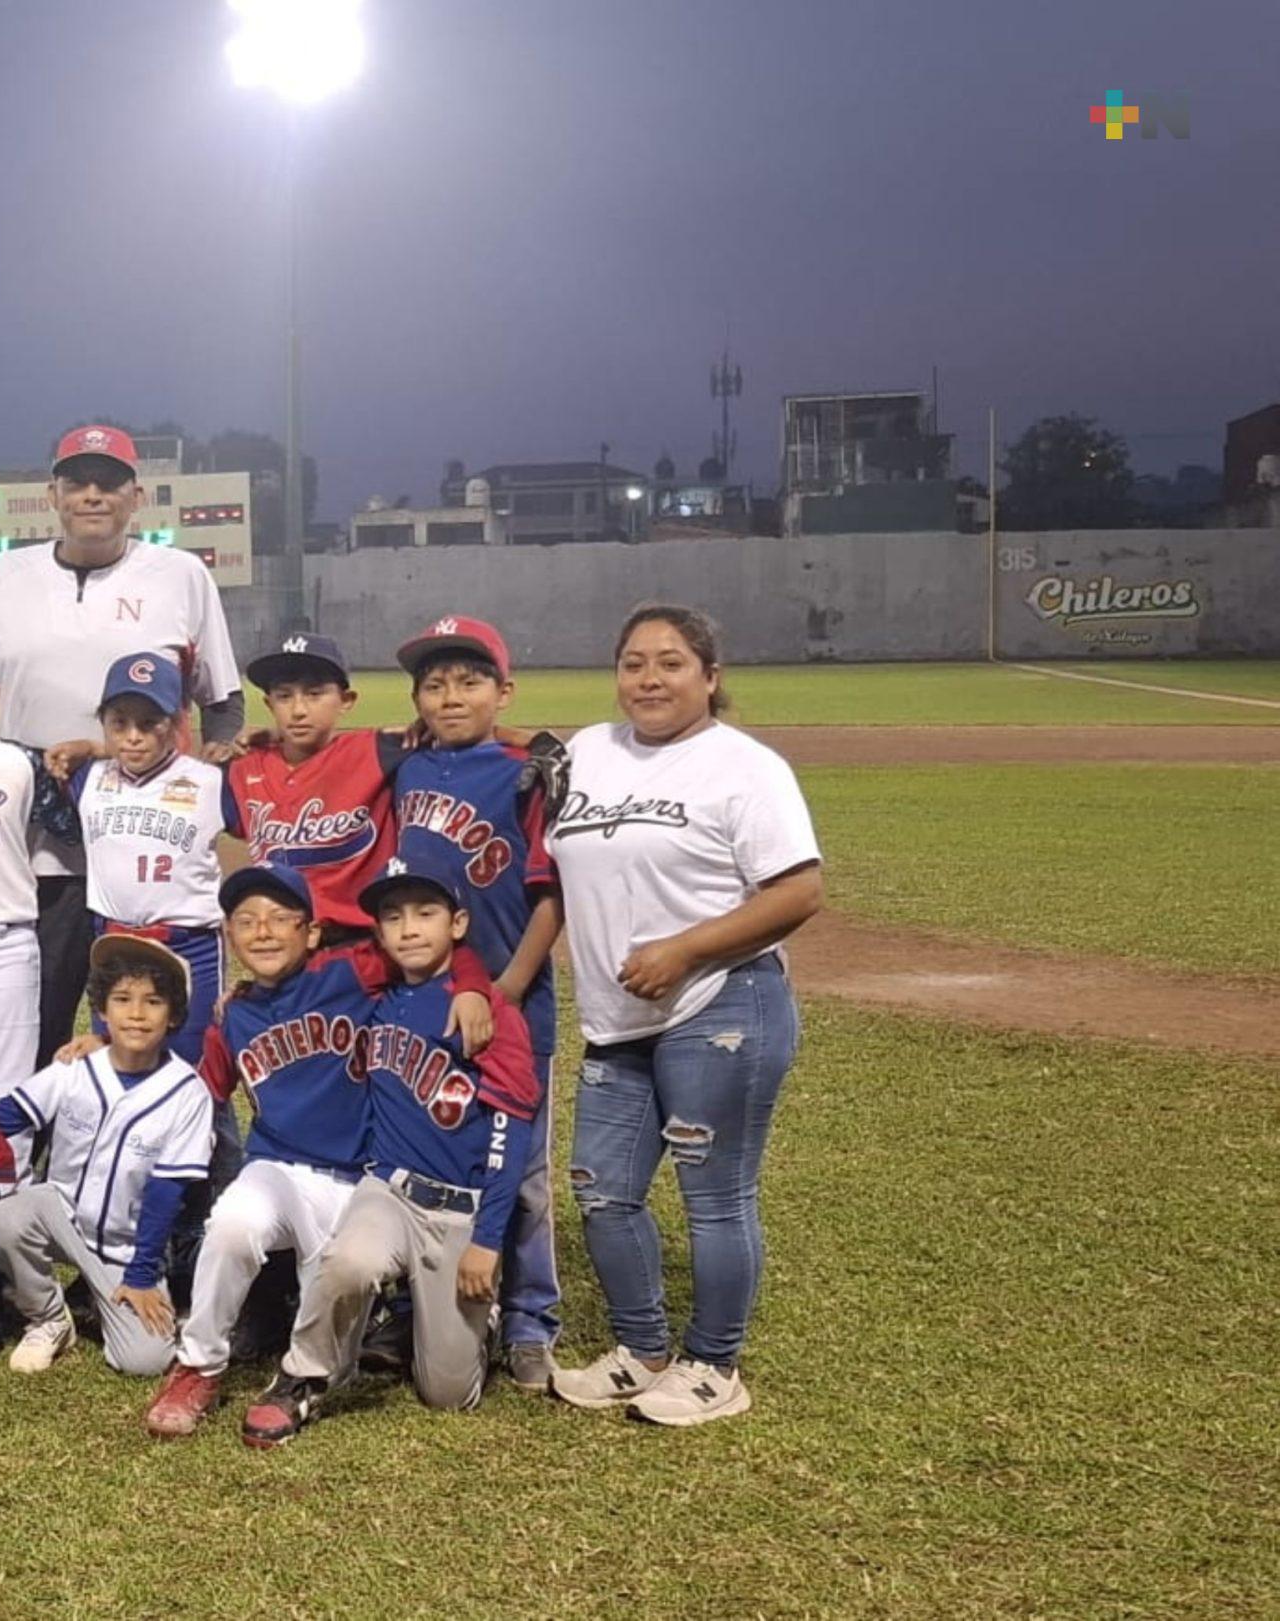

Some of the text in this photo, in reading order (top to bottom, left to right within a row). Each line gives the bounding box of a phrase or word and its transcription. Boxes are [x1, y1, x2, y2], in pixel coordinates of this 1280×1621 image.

[998, 547, 1037, 572] 315
[116, 597, 145, 622] N
[1026, 576, 1194, 619] Chileros
[128, 659, 154, 684] C
[245, 798, 372, 860] Yankees
[557, 791, 688, 840] Dodgers
[137, 854, 173, 883] 12
[487, 1111, 509, 1170] ONE
